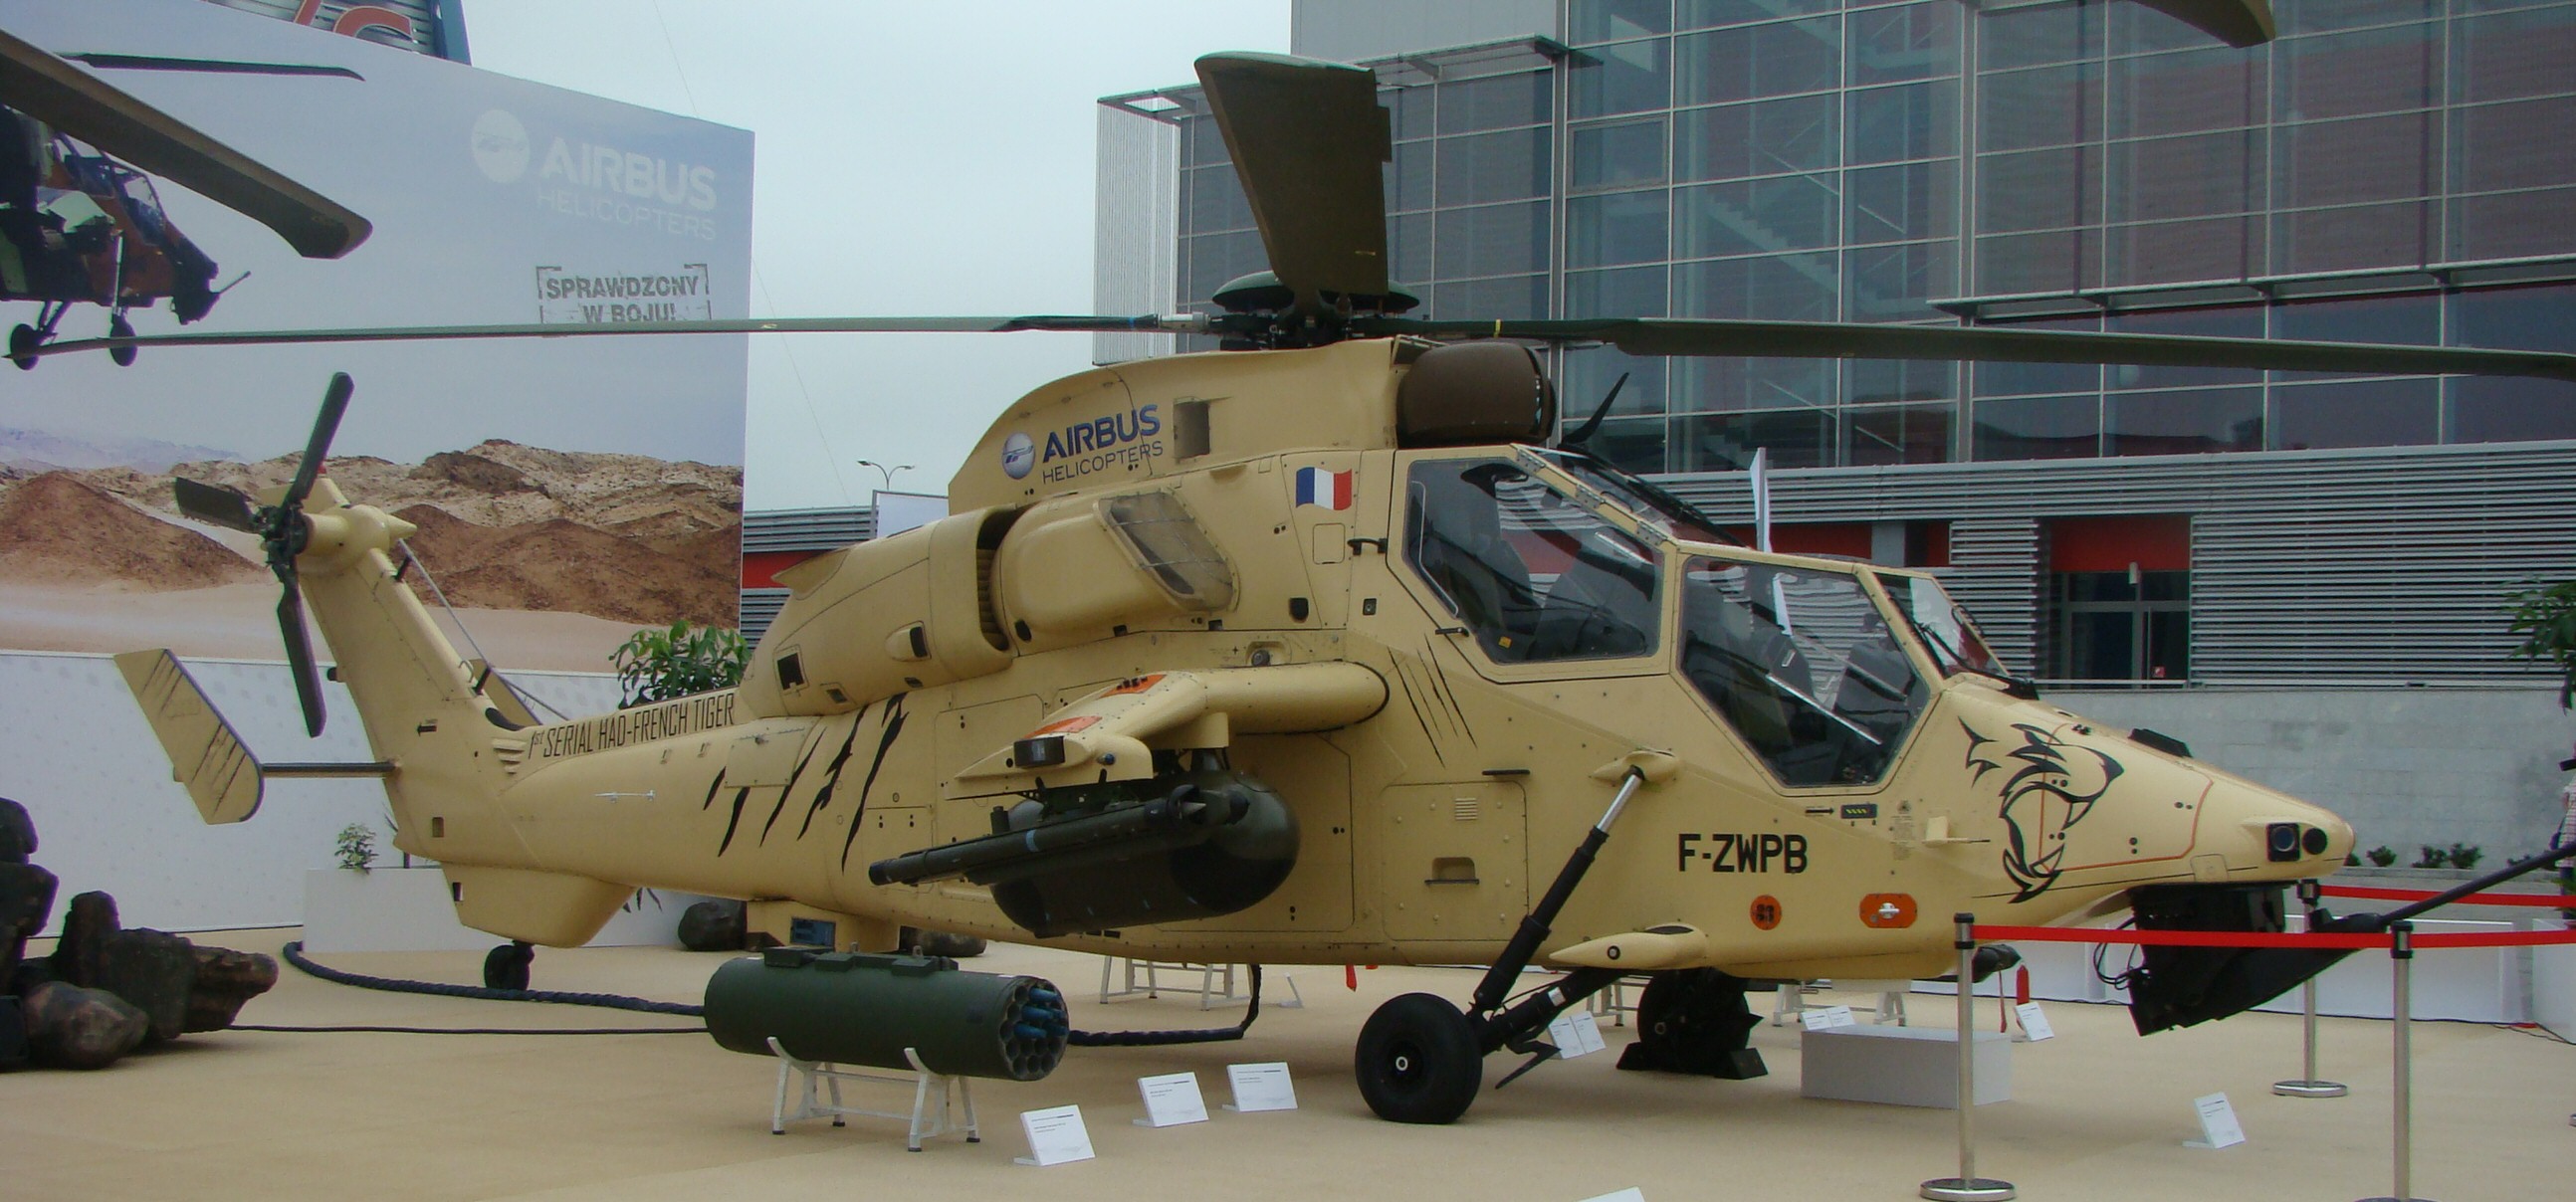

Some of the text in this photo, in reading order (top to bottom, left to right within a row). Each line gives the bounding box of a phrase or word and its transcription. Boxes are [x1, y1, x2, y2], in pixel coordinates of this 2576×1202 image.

[539, 136, 718, 211] AIRBUS
[537, 185, 717, 241] HELICOPTERS
[546, 275, 699, 300] SPRAWDZONY
[583, 303, 603, 323] W
[1042, 404, 1161, 464] AIRBUS
[1041, 440, 1164, 485] HELICOPTERS
[542, 720, 594, 758] SERIAL
[597, 700, 688, 751] HAD-FRENCH
[693, 692, 735, 732] TIGER
[1678, 833, 1808, 874] F-ZWPB
